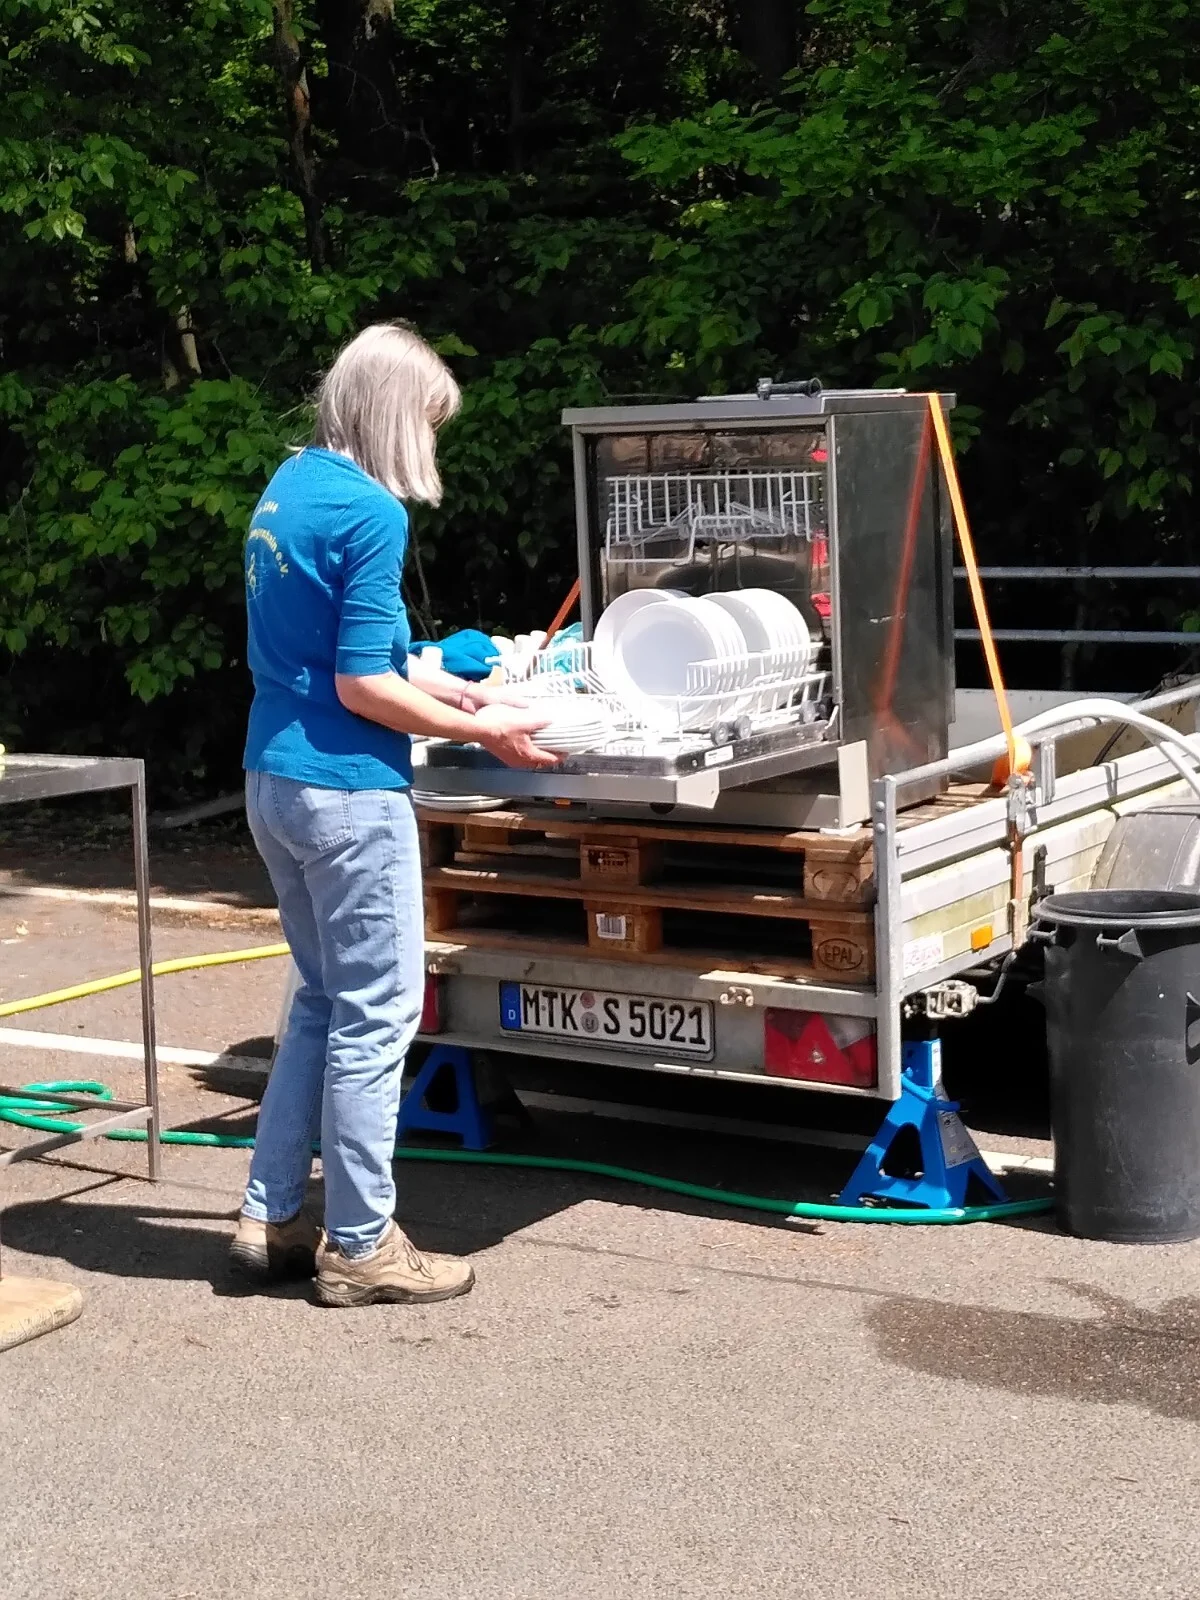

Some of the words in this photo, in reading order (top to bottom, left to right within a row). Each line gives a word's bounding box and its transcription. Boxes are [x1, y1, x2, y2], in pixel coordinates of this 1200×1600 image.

[824, 945, 857, 965] EPAL
[508, 1009, 516, 1020] D
[522, 988, 580, 1031] MTK
